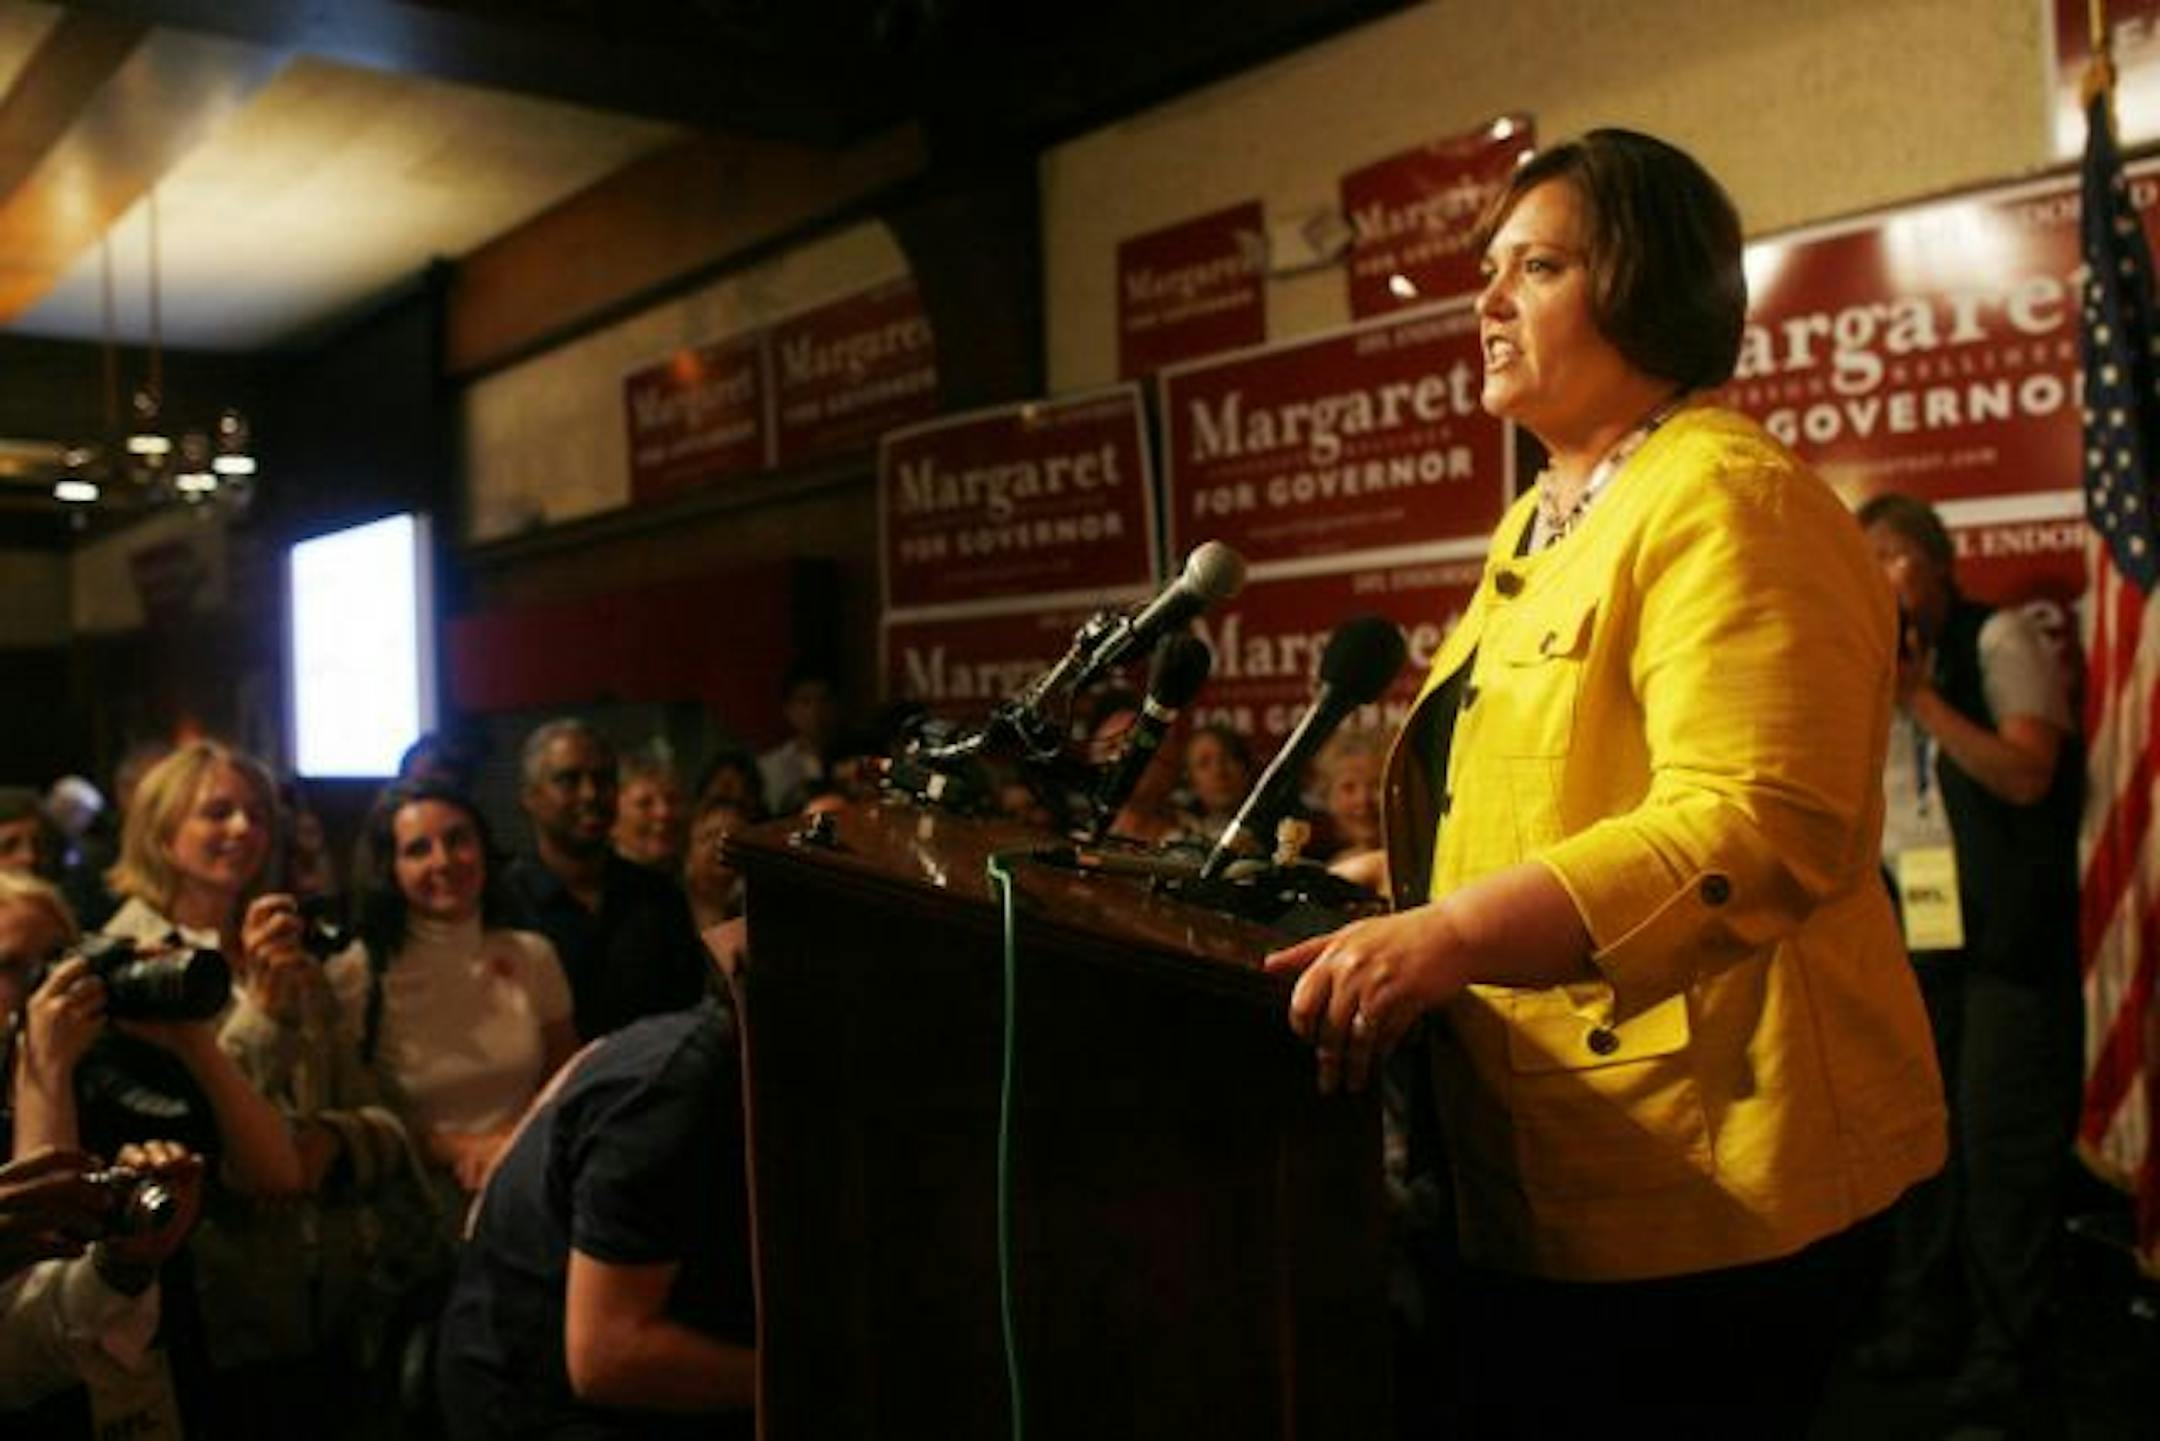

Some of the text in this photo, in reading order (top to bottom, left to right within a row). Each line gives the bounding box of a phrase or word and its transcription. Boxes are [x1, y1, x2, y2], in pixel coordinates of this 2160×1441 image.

[1734, 262, 2090, 397] argare
[1189, 357, 1477, 467] Margaret
[899, 441, 1123, 524] Margaret
[1193, 480, 1258, 519] FOR
[1266, 445, 1475, 508] GOVERNOR
